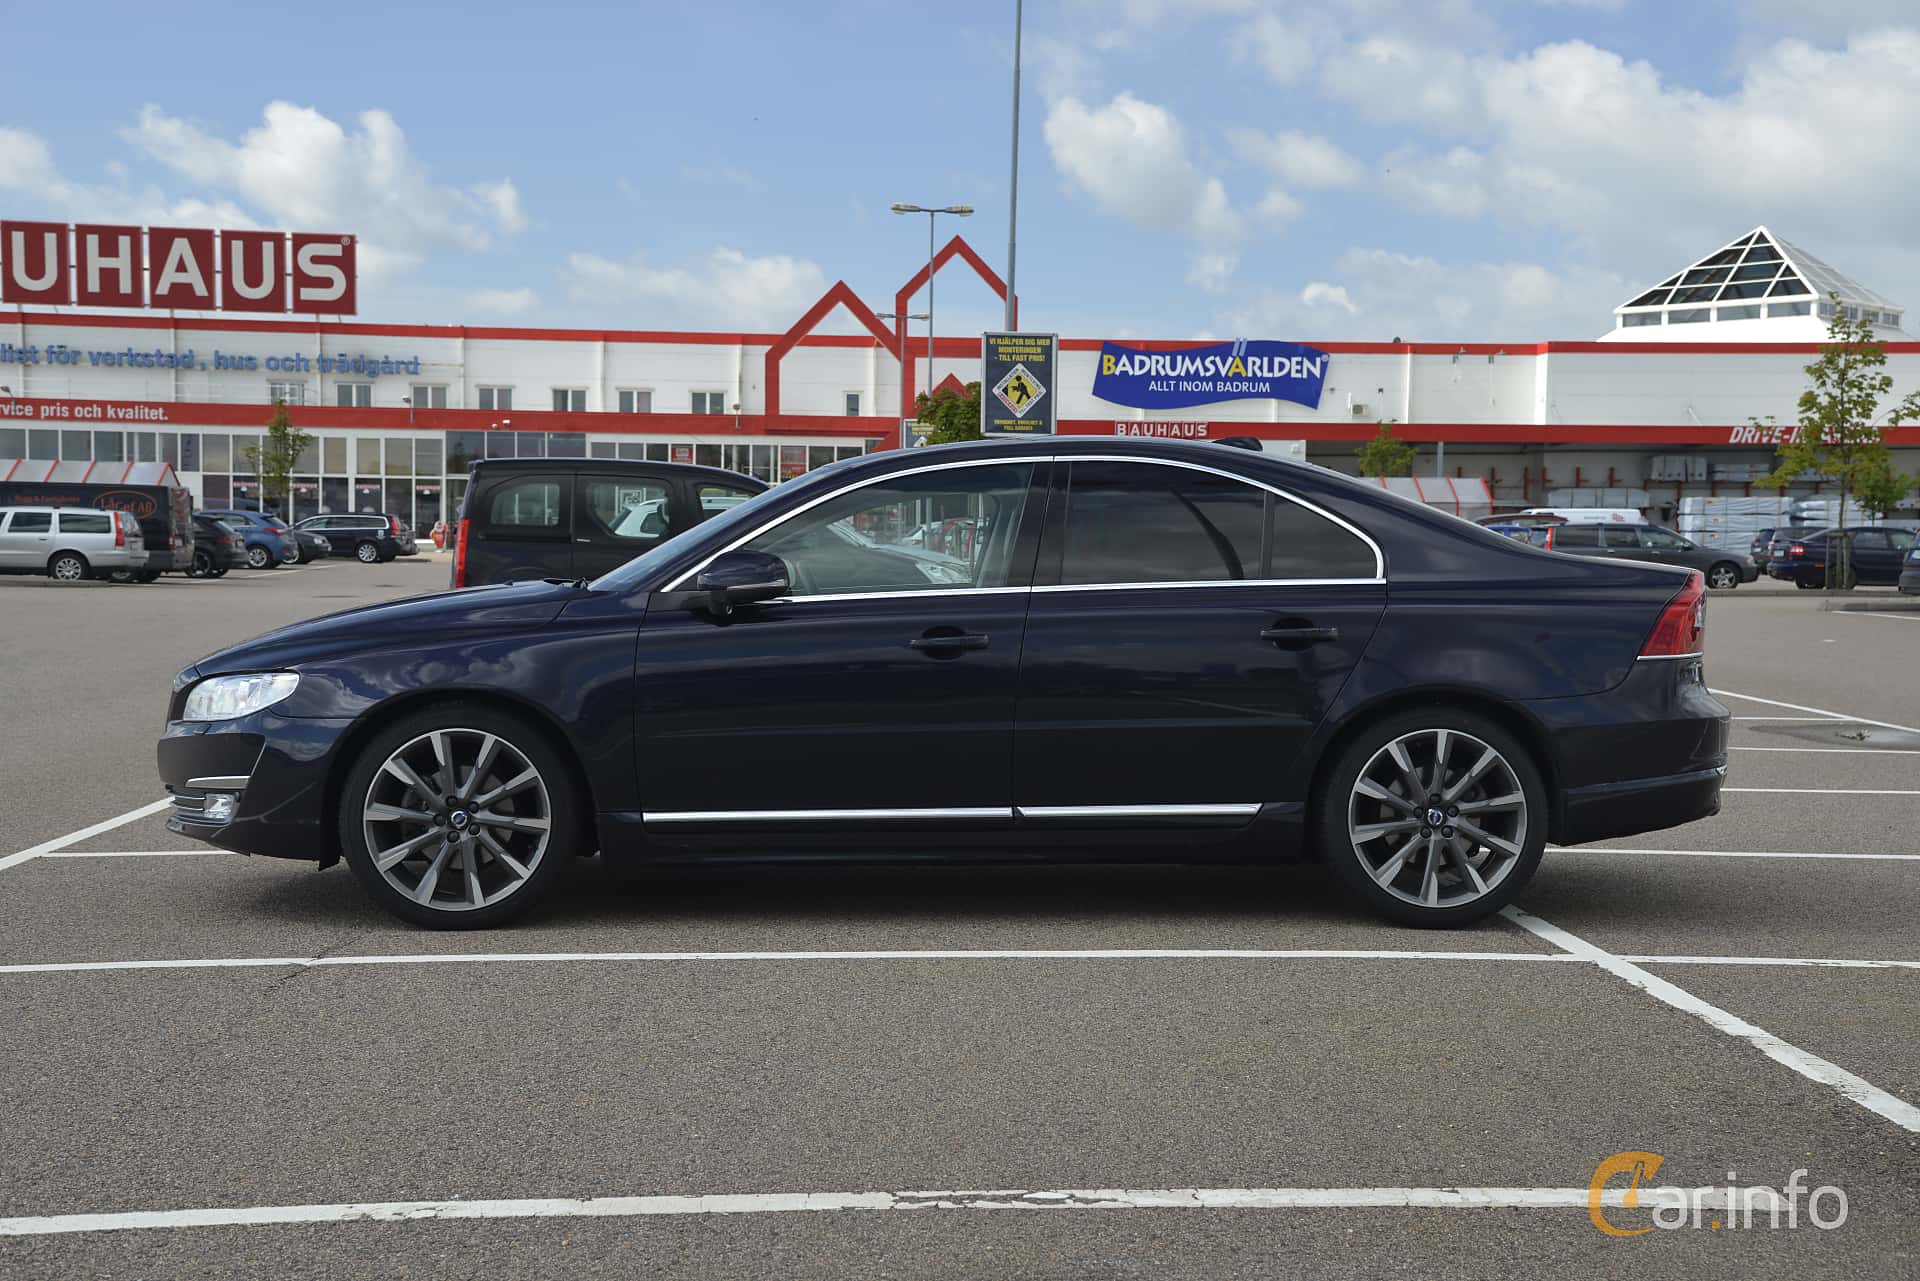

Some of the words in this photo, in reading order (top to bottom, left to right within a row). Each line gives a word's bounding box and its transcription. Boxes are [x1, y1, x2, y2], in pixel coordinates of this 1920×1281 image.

[45, 345, 81, 365] för
[214, 349, 257, 371] hus
[265, 352, 310, 372] och
[317, 353, 420, 377] trädgård
[1102, 338, 1321, 379] BADRUMSVÄRLDEN
[1149, 381, 1175, 392] ALLT
[1179, 381, 1213, 392] INOM
[1216, 381, 1270, 393] BADRUM
[40, 402, 70, 419] pris
[75, 404, 102, 419] och
[106, 405, 168, 421] kvalitet.
[1116, 423, 1208, 437] BAUHAUS
